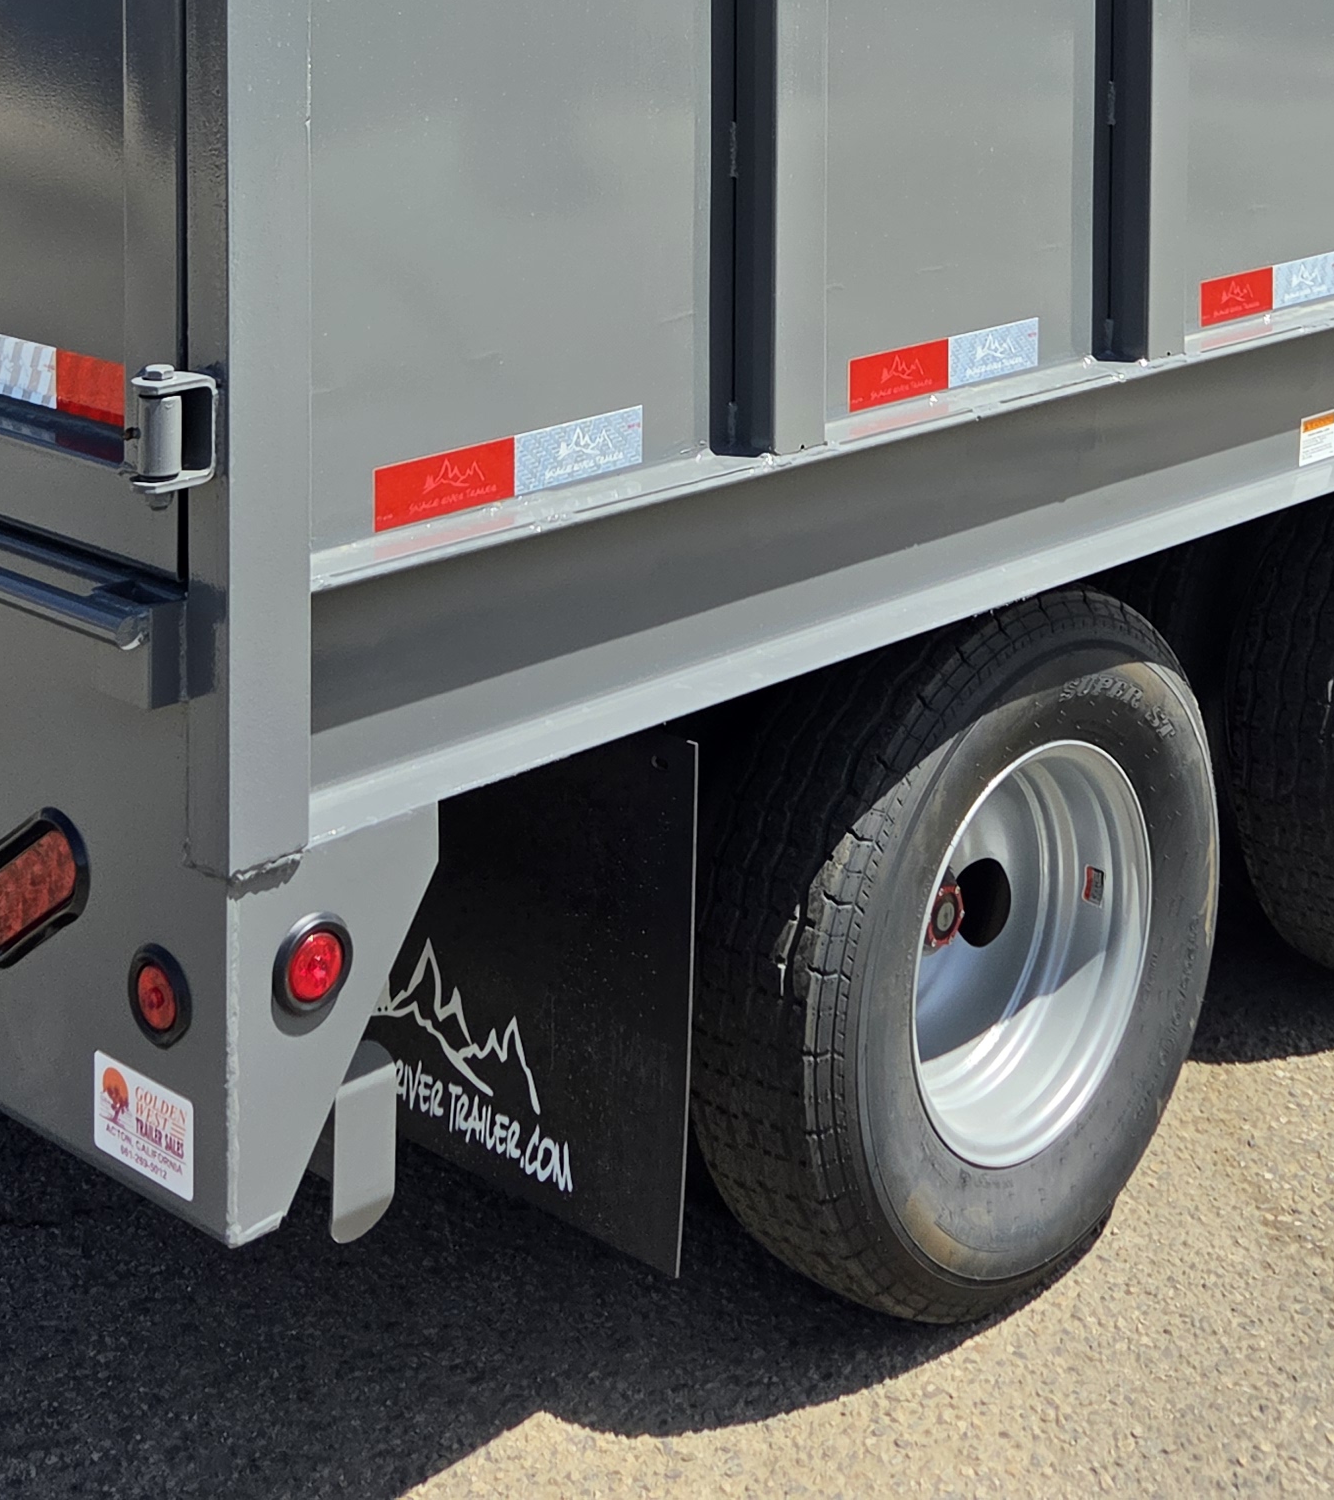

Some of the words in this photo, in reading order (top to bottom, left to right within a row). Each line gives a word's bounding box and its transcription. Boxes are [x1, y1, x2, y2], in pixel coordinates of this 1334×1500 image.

[1058, 673, 1144, 710] SUPER
[1144, 704, 1176, 741] ST
[135, 1085, 186, 1125] GOLDEN
[135, 1101, 168, 1131] WEST
[135, 1116, 163, 1148] TRAILER
[164, 1133, 185, 1160] SALES
[135, 1139, 184, 1176] CALIFORNIA
[447, 1082, 574, 1193] TRAILER.COM
